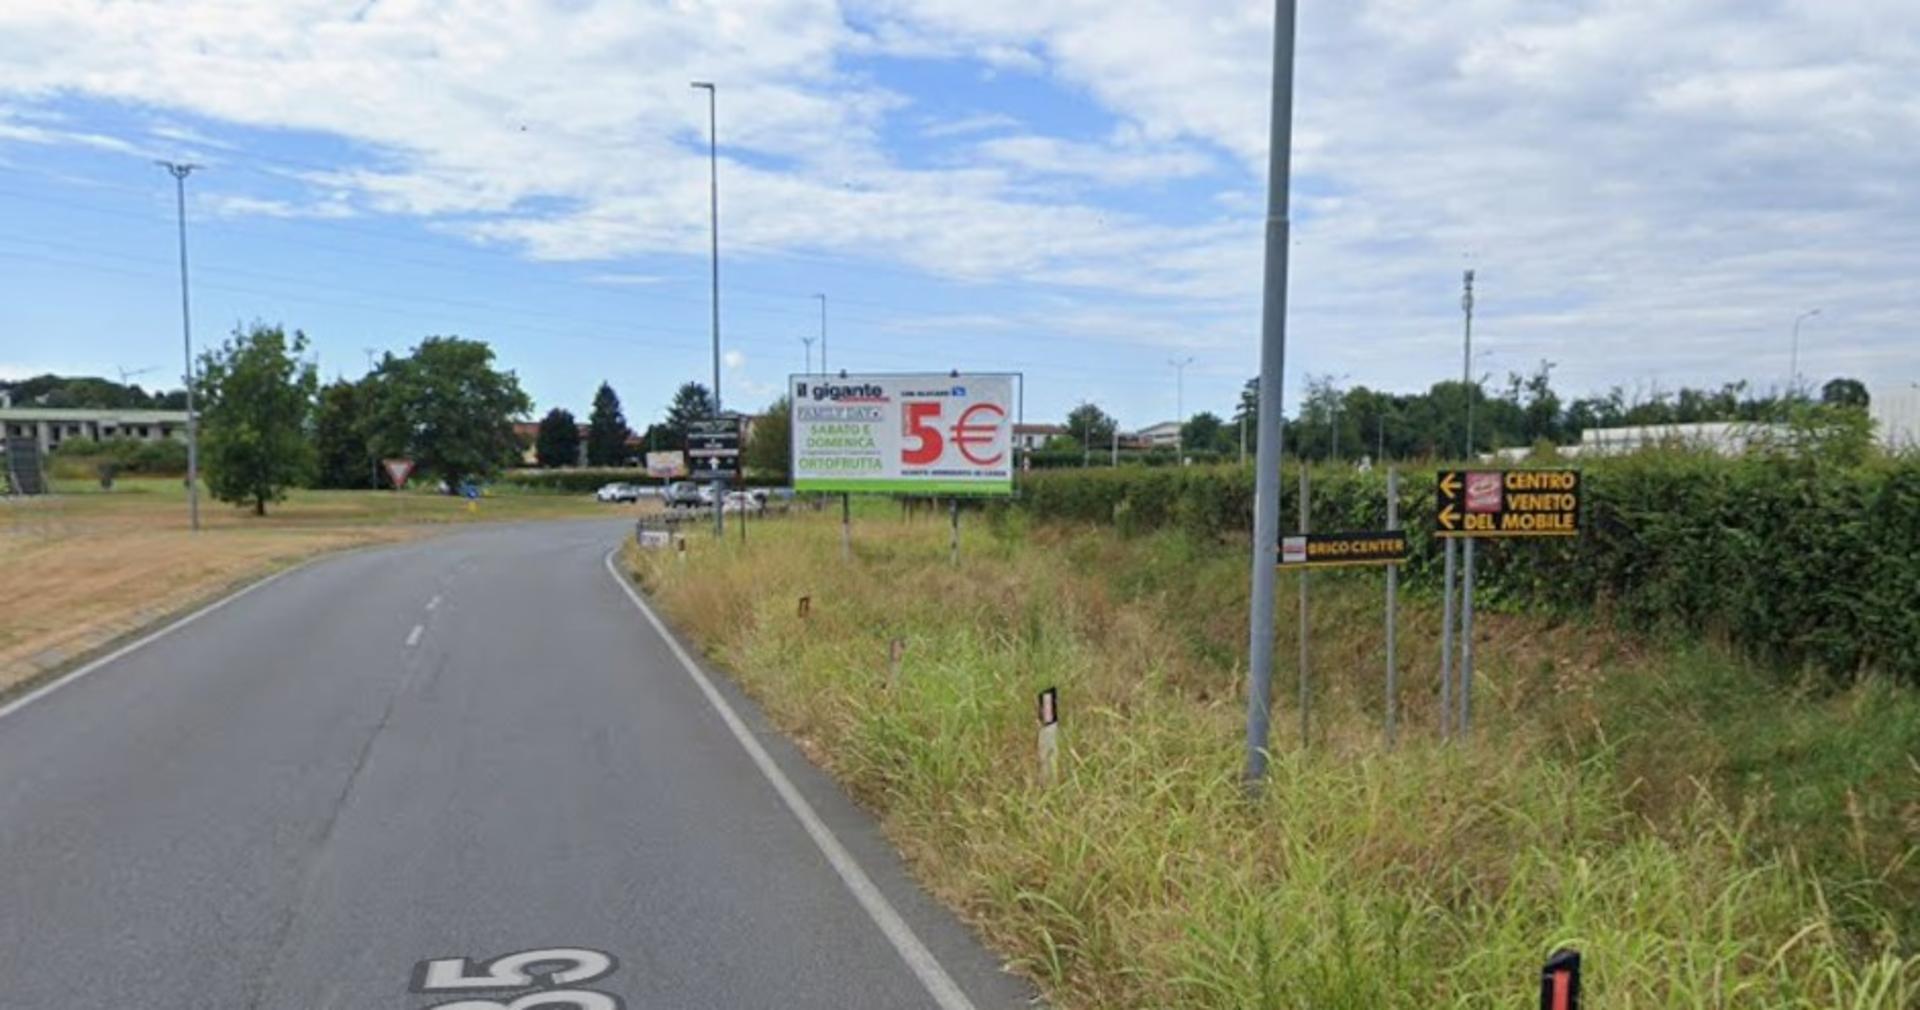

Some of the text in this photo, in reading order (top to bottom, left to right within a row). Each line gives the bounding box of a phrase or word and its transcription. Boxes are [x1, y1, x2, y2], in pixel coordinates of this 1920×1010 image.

[797, 383, 882, 401] il gigante
[811, 424, 871, 436] SABATO E
[807, 438, 876, 448] DOMENICA
[799, 457, 882, 470] ORTOFRUTTA
[1505, 472, 1575, 489] CENTRO
[1507, 494, 1575, 510] VENETO
[1464, 513, 1575, 530] DEL MOBILE
